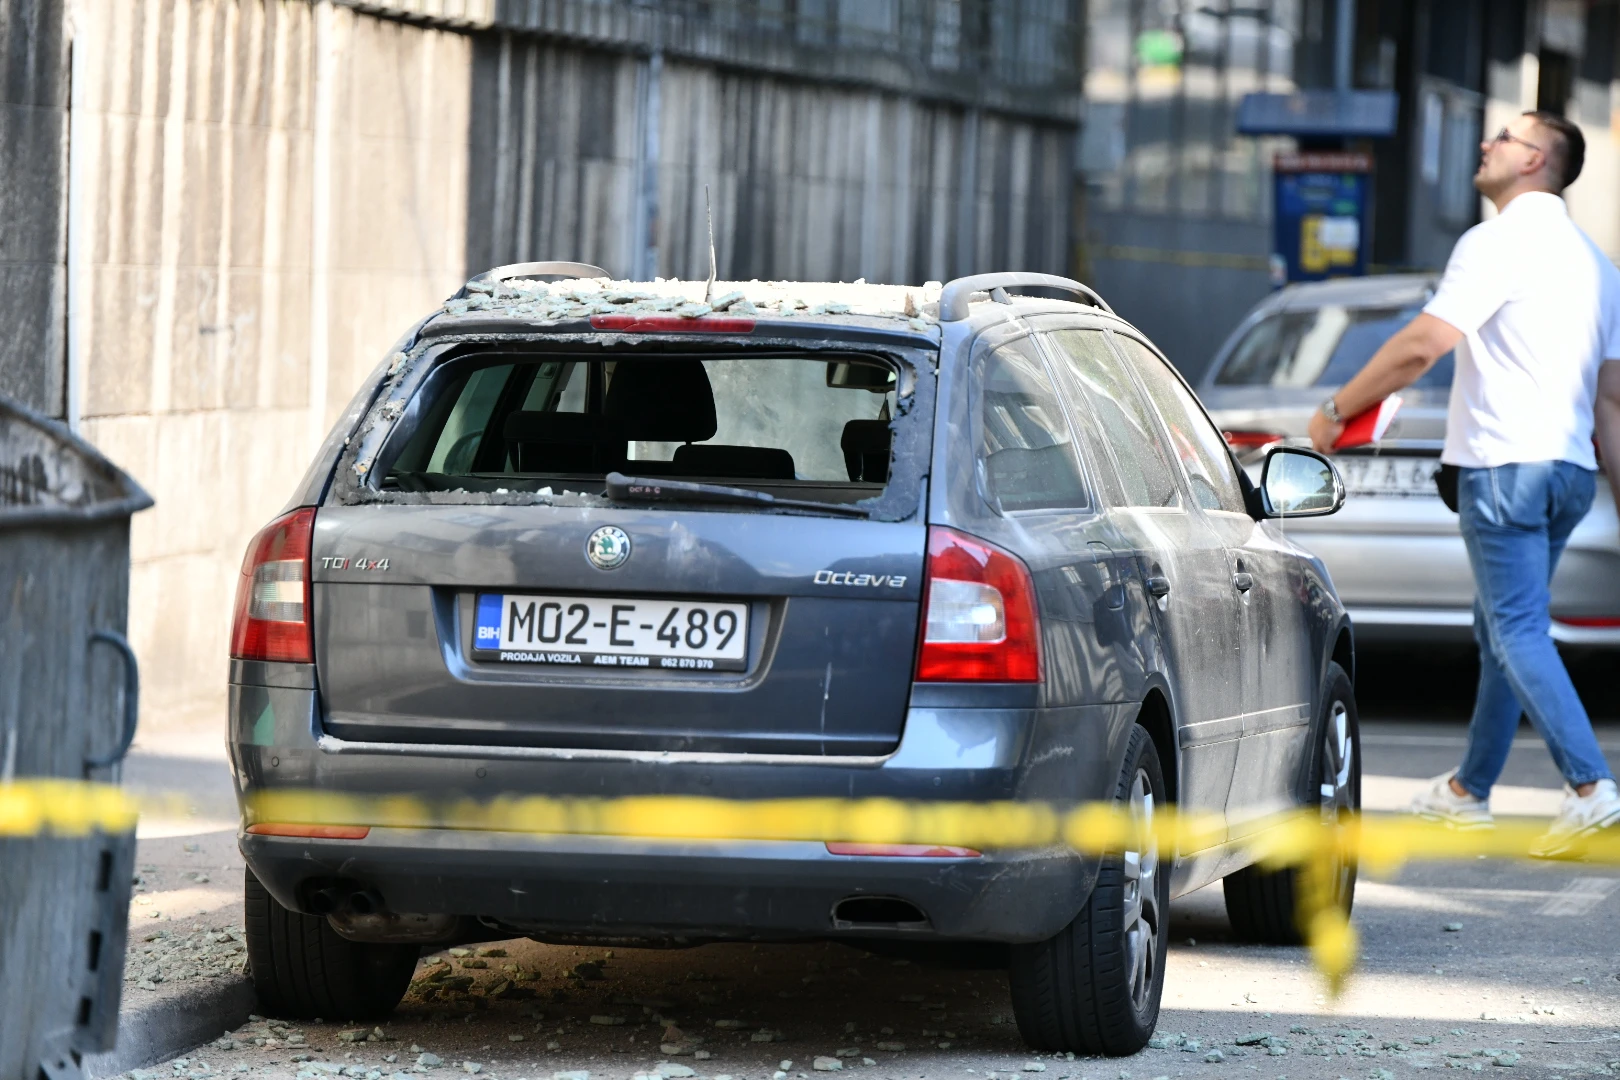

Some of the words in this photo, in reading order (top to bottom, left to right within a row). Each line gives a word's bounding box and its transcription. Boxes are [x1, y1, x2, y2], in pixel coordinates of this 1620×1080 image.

[355, 558, 389, 570] 4x4
[813, 570, 907, 588] Octavia
[478, 626, 500, 639] BIH
[500, 652, 546, 662] PRODAJA
[547, 653, 581, 663] VOZILA
[593, 655, 617, 664] AEM
[620, 656, 649, 666] TEAM
[661, 658, 677, 667] 062
